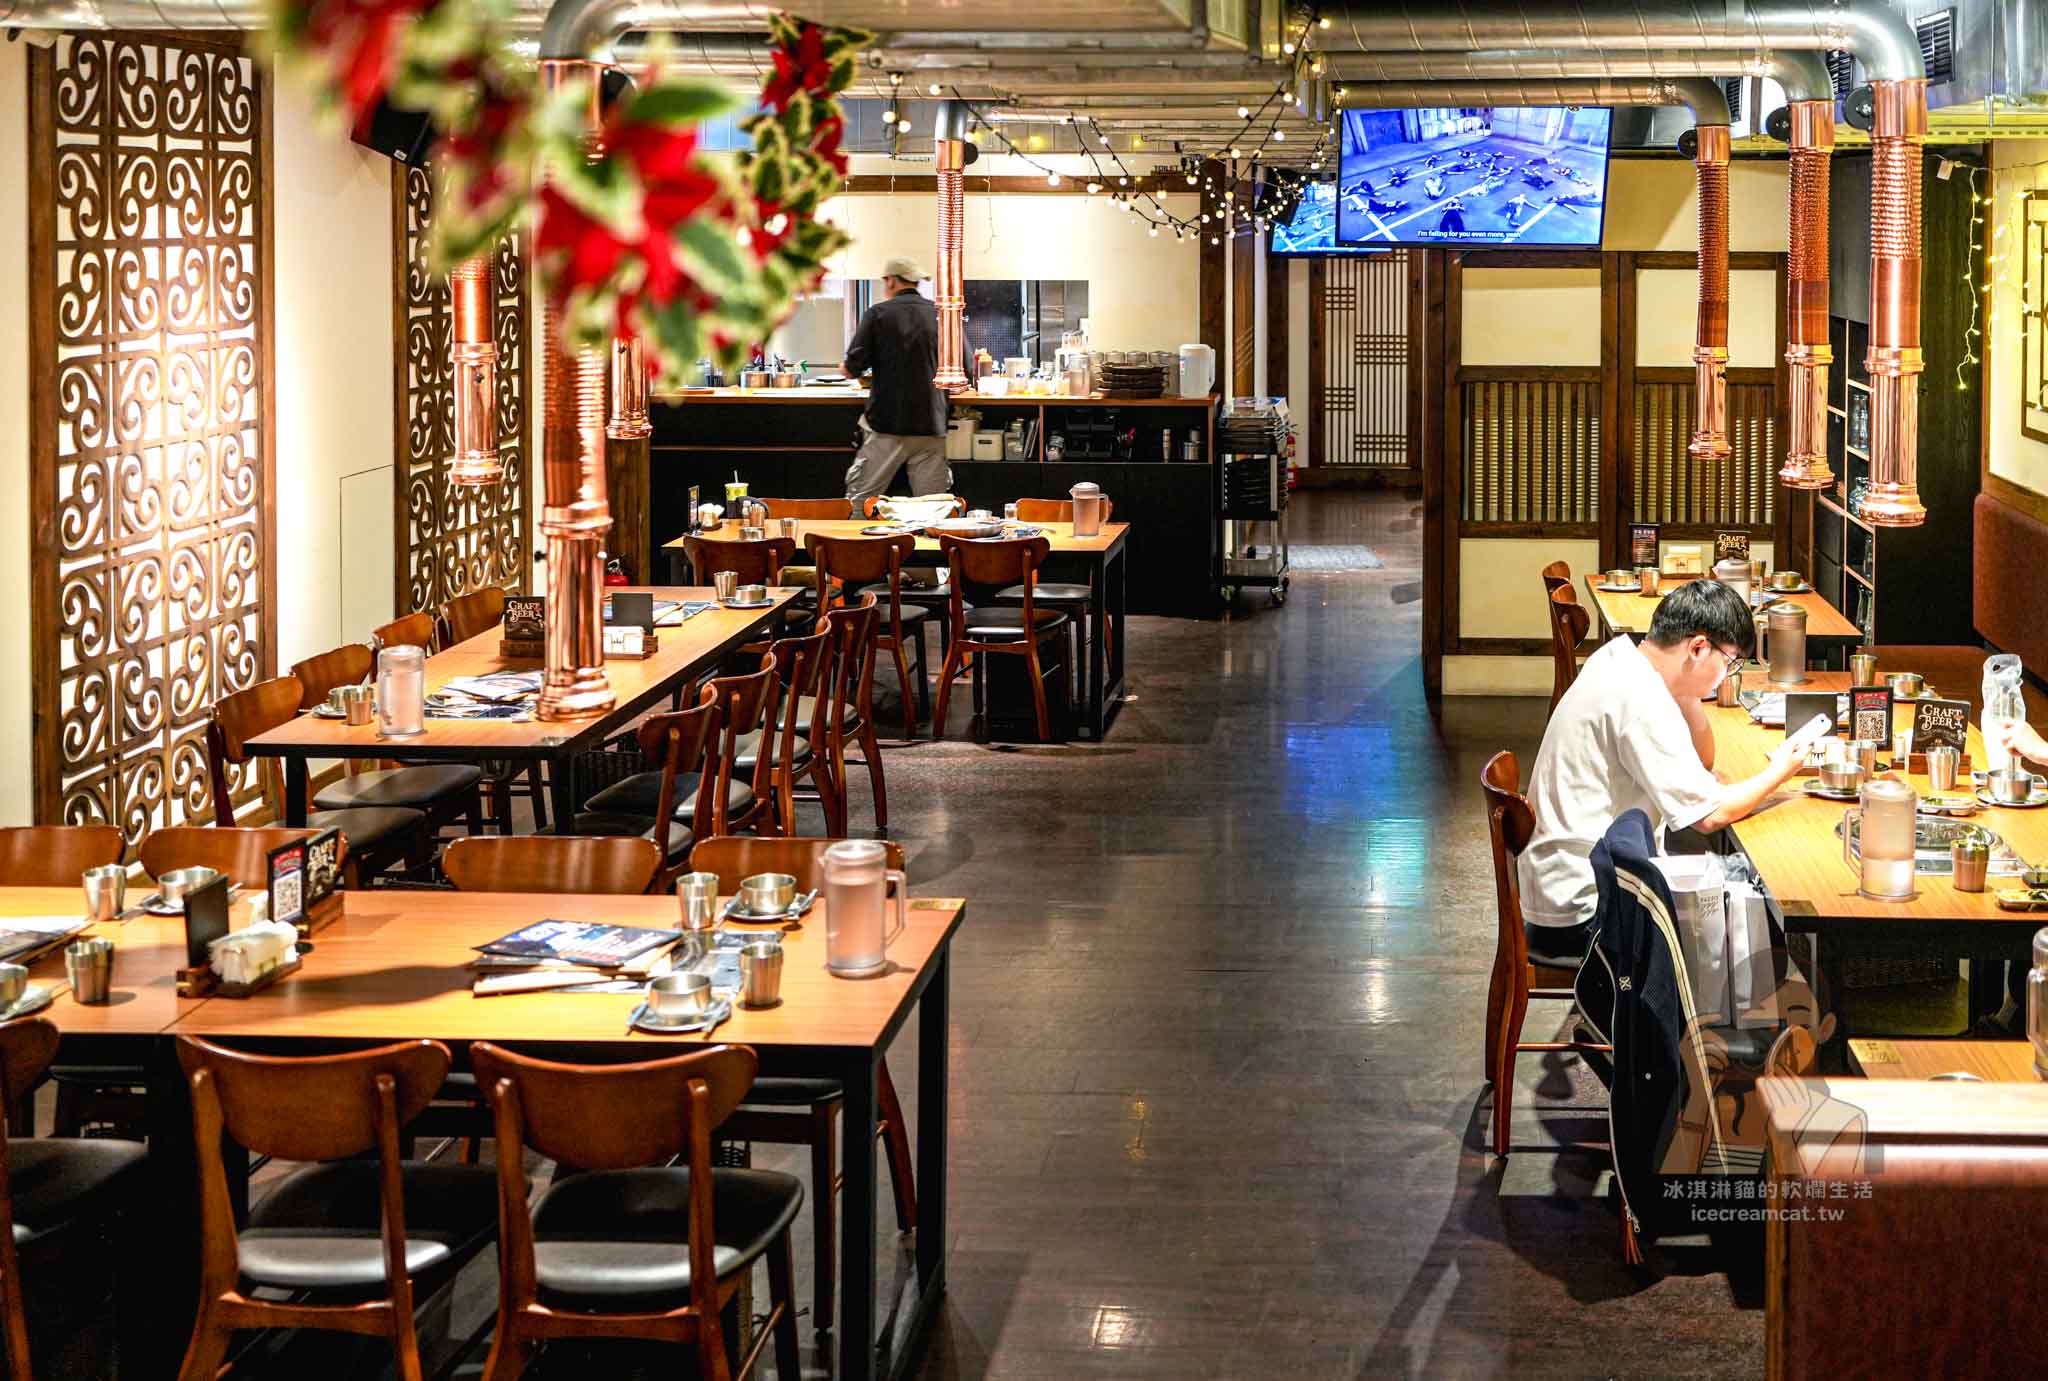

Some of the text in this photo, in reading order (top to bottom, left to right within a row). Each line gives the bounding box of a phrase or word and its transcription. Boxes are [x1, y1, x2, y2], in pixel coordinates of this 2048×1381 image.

[1718, 533, 1746, 542] CRAFT
[1716, 540, 1742, 551] BEER
[508, 600, 541, 611] CRAFT
[506, 609, 538, 622] BEER
[1921, 704, 1962, 717] CRAFT
[1918, 714, 1956, 731] BEER
